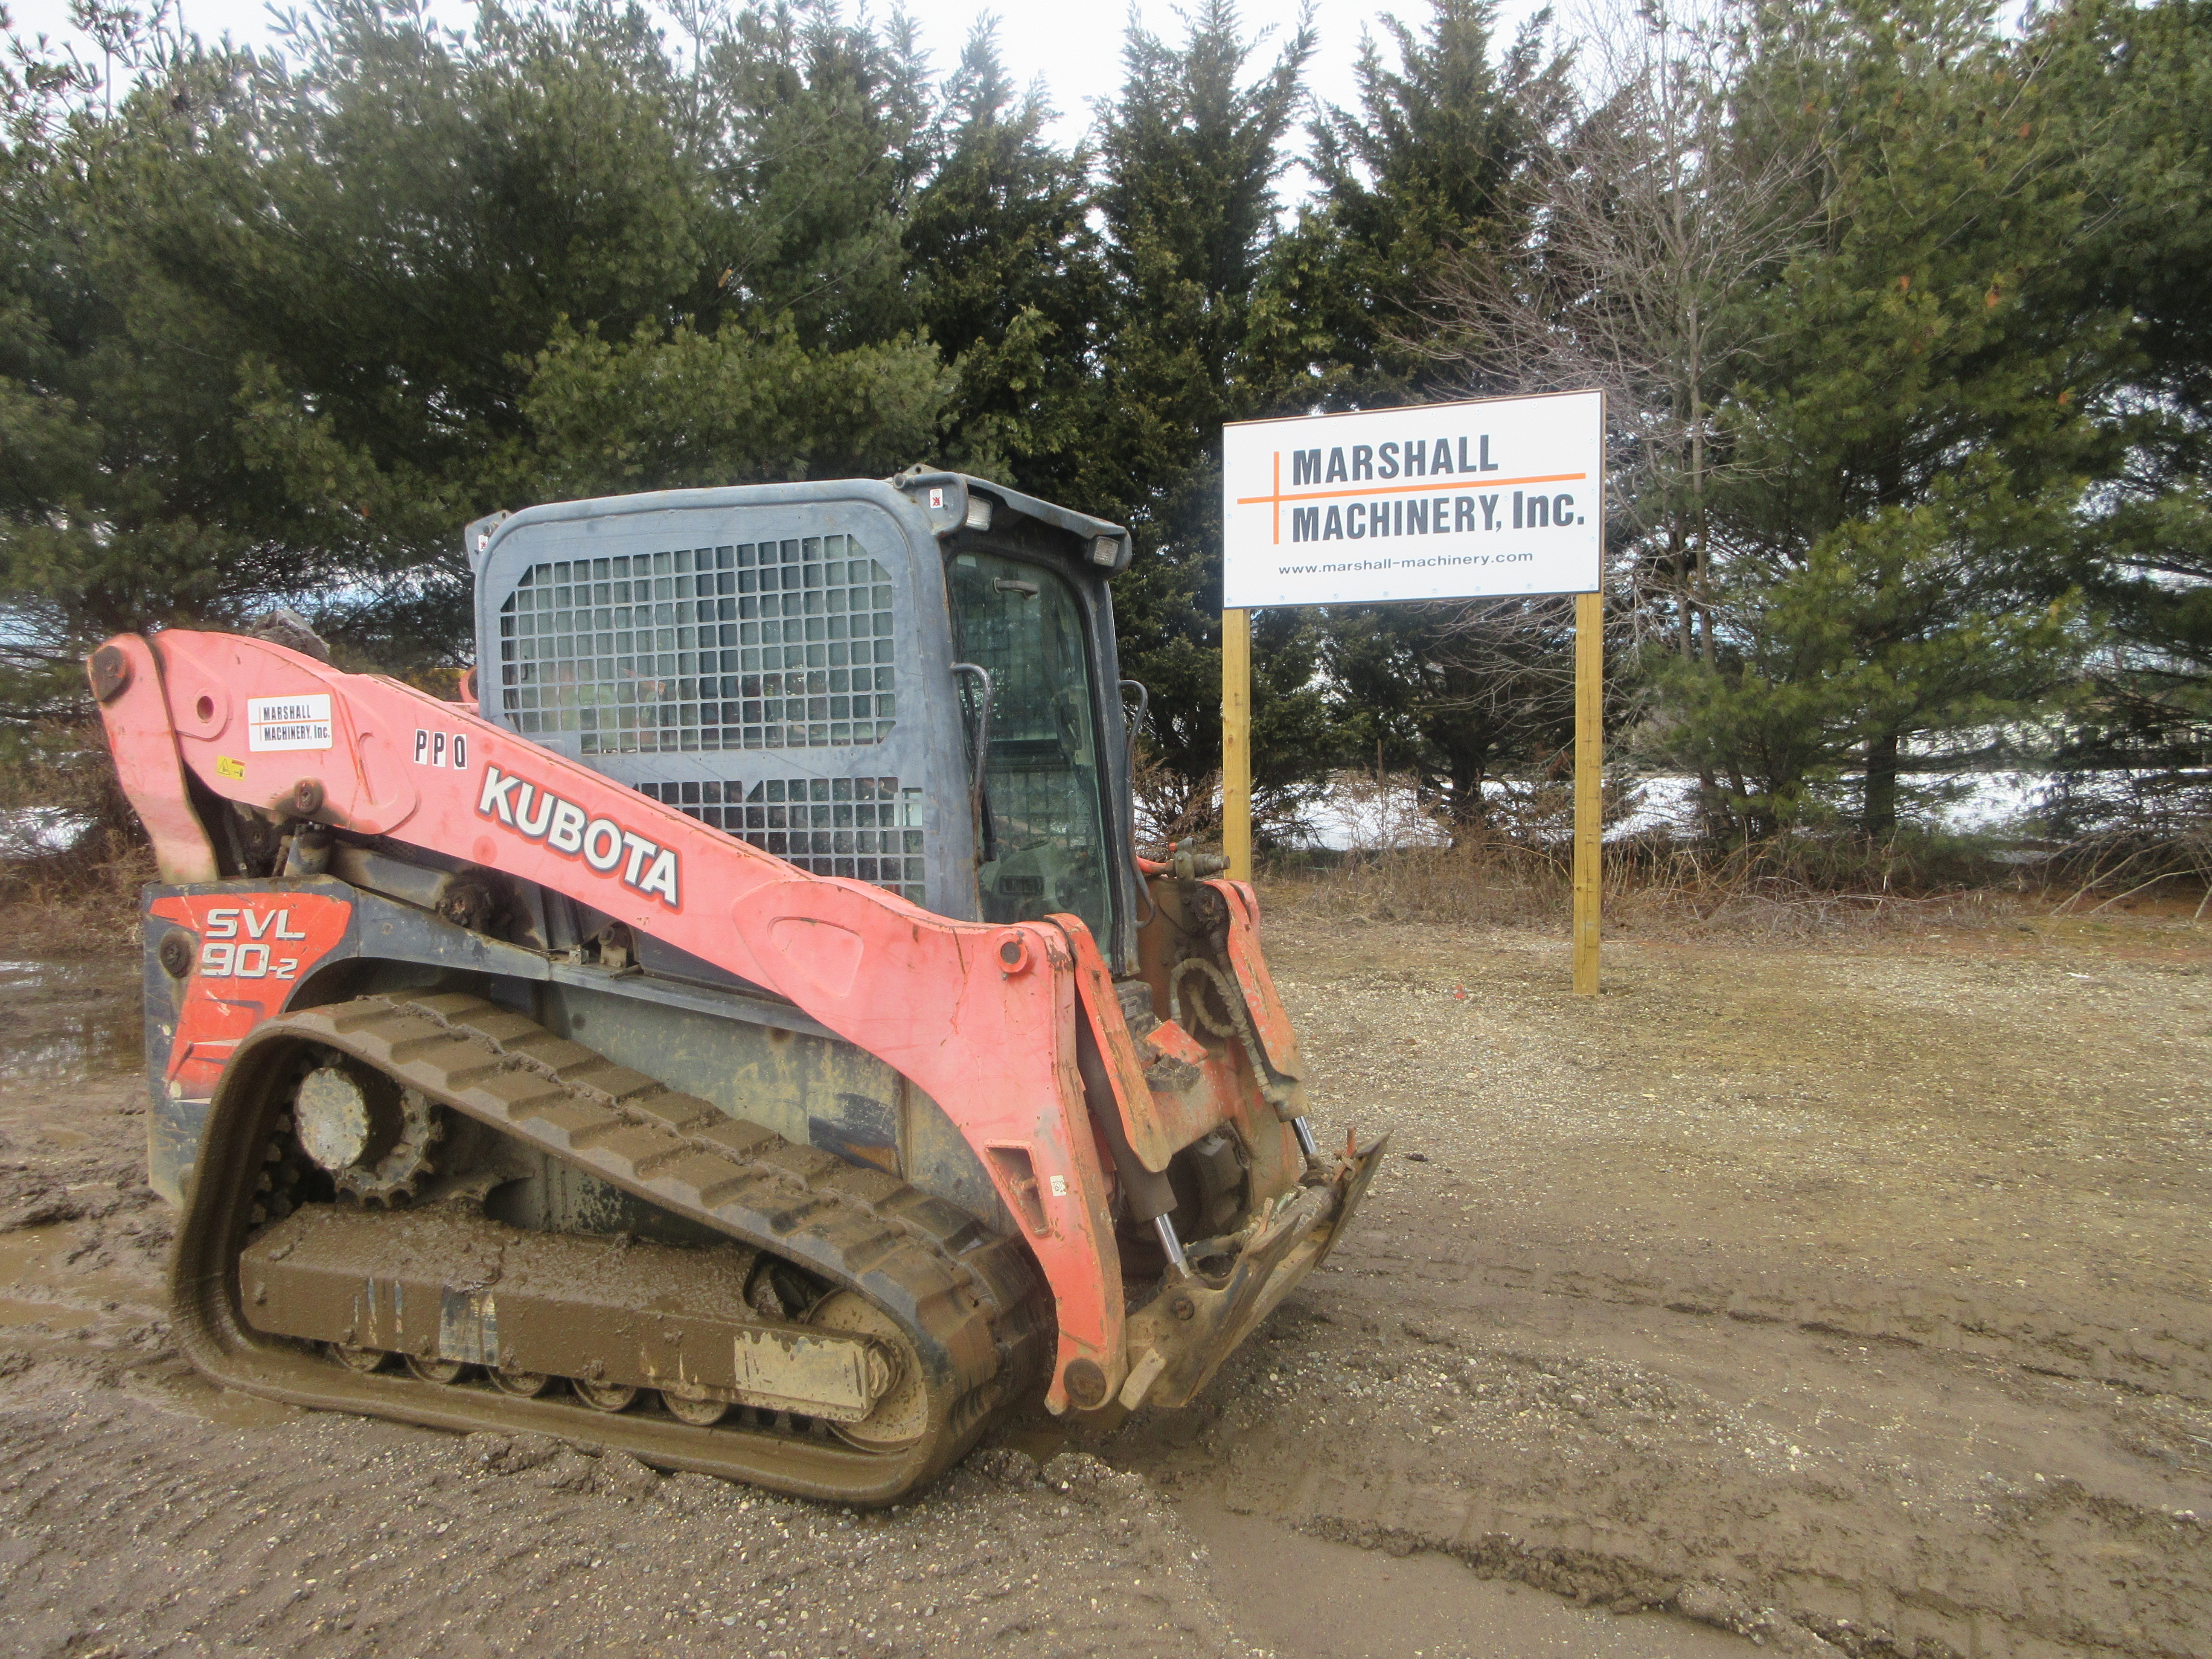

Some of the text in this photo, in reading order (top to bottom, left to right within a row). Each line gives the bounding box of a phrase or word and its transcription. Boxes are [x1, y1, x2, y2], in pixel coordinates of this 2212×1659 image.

[1293, 434, 1499, 486] MARSHALL
[1292, 491, 1585, 542] MACHINERY, Inc.
[1278, 551, 1534, 574] www.marshall-machinery.com
[263, 704, 311, 721] MARSHALL
[264, 725, 330, 741] MACHINERY, Inc.
[479, 766, 678, 906] KUBOTA
[205, 908, 306, 940] SVL
[200, 943, 298, 979] 90-2
